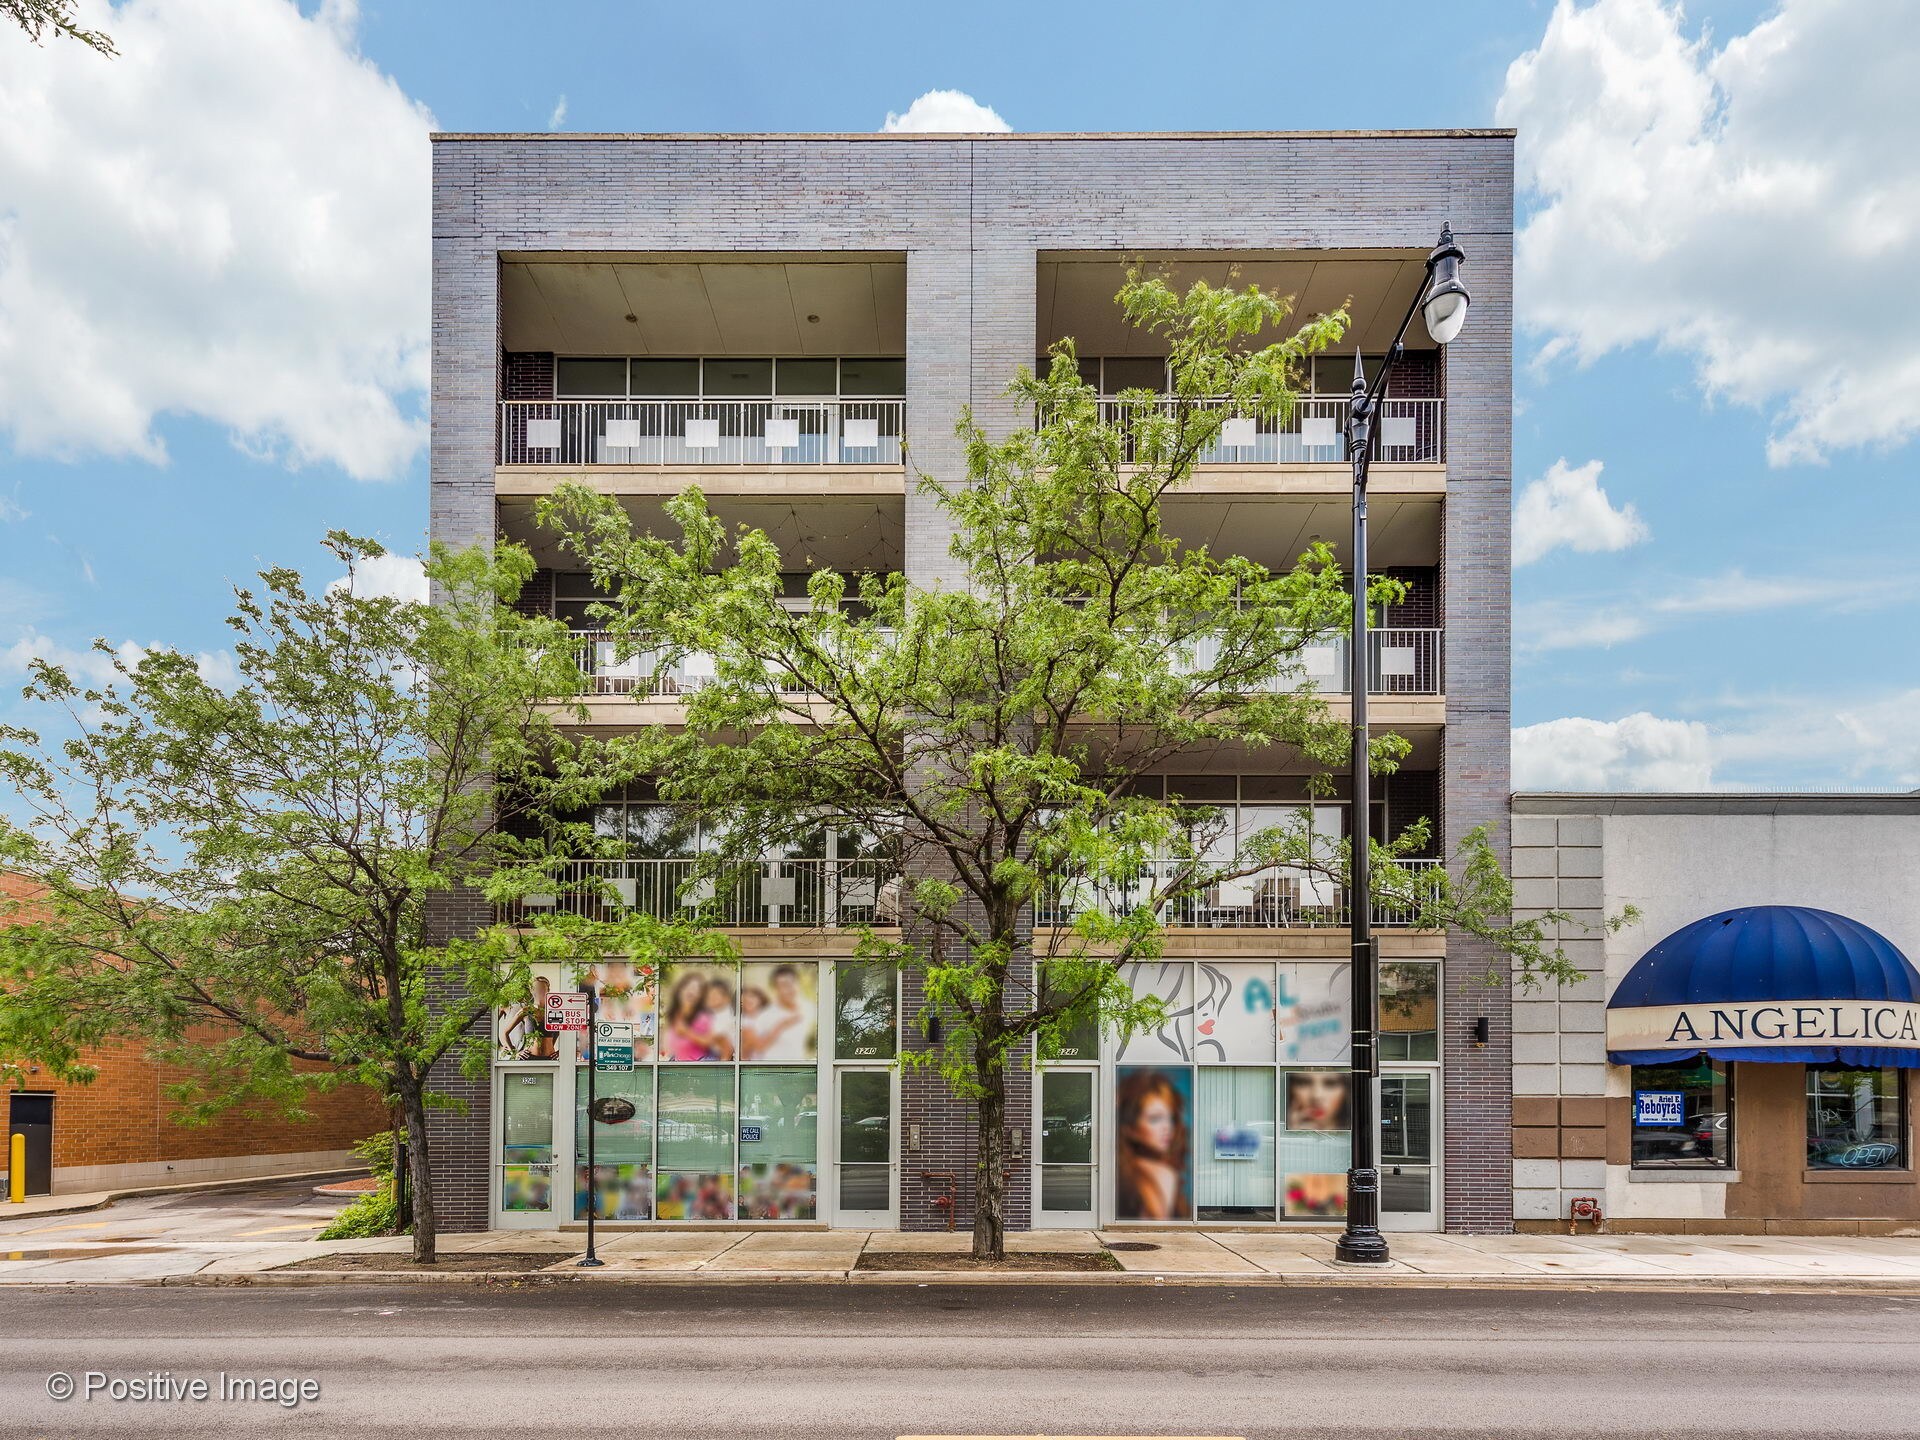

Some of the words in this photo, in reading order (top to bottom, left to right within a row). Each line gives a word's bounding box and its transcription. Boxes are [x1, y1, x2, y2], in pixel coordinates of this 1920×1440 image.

[1658, 1095, 1673, 1103] Ariel
[1639, 1100, 1681, 1117] Reboyras
[1842, 1147, 1893, 1164] OPEN
